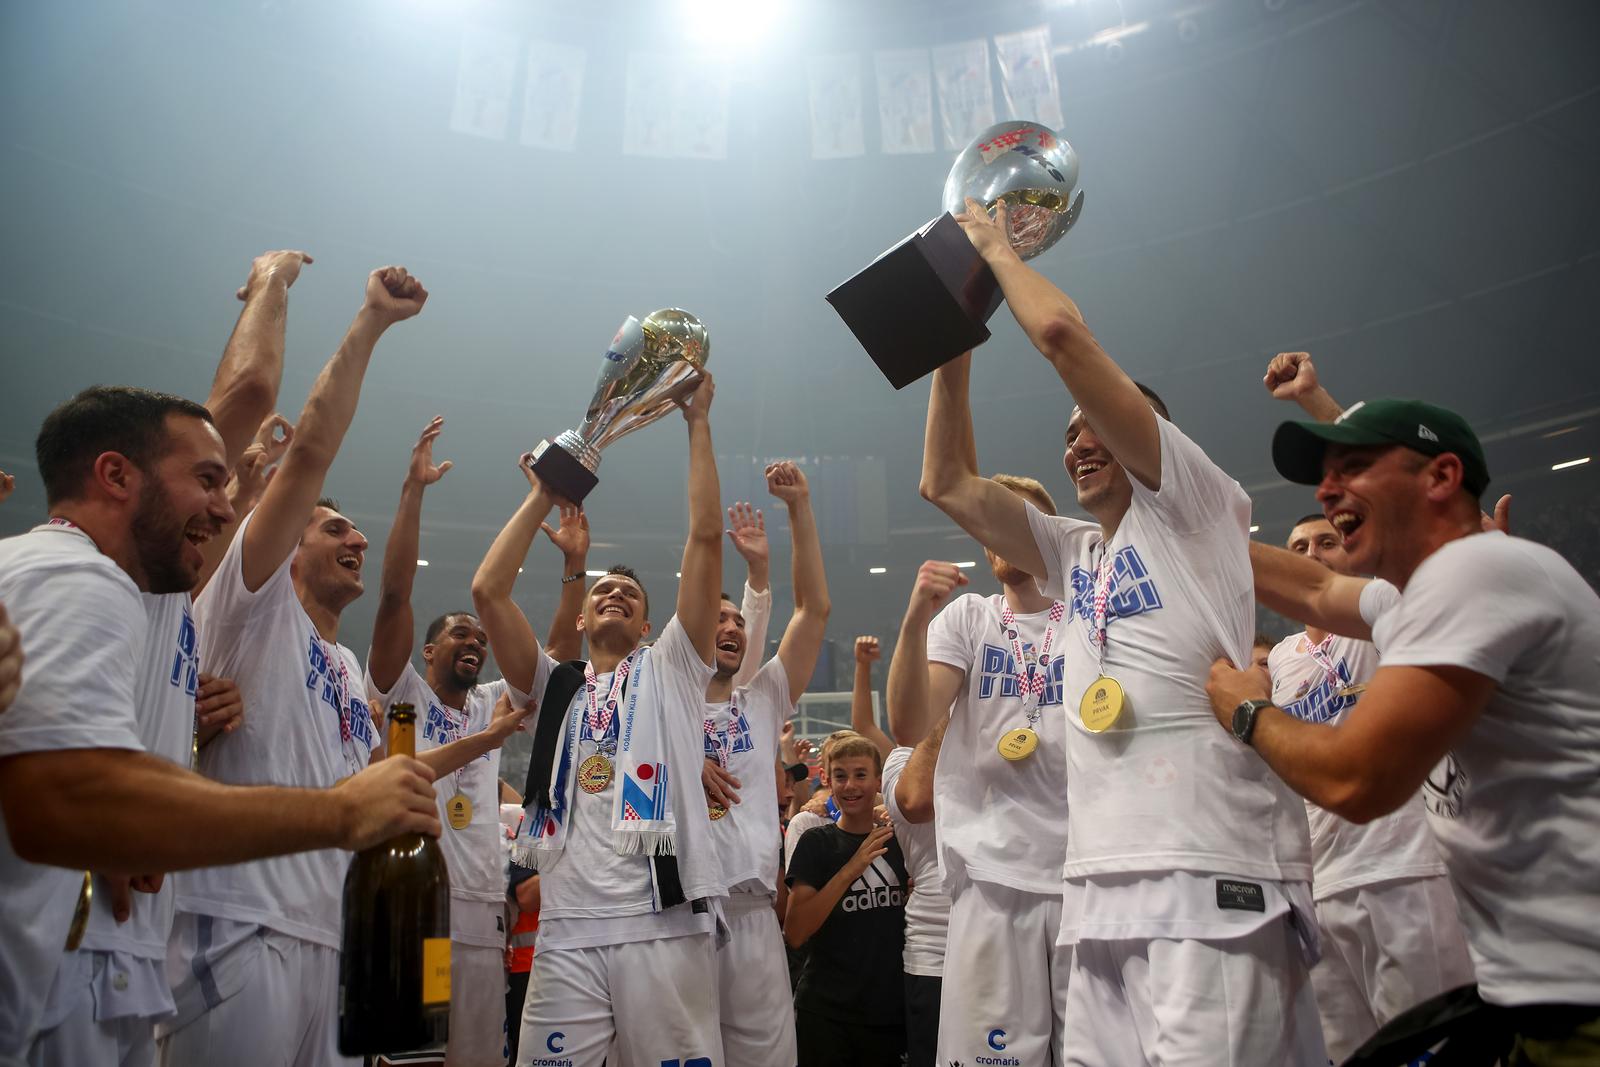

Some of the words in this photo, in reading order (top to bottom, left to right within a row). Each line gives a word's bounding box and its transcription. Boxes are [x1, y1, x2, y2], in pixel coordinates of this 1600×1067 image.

[1222, 883, 1257, 895] macron
[532, 1057, 573, 1067] cromaris
[975, 1056, 1020, 1066] cromaris
